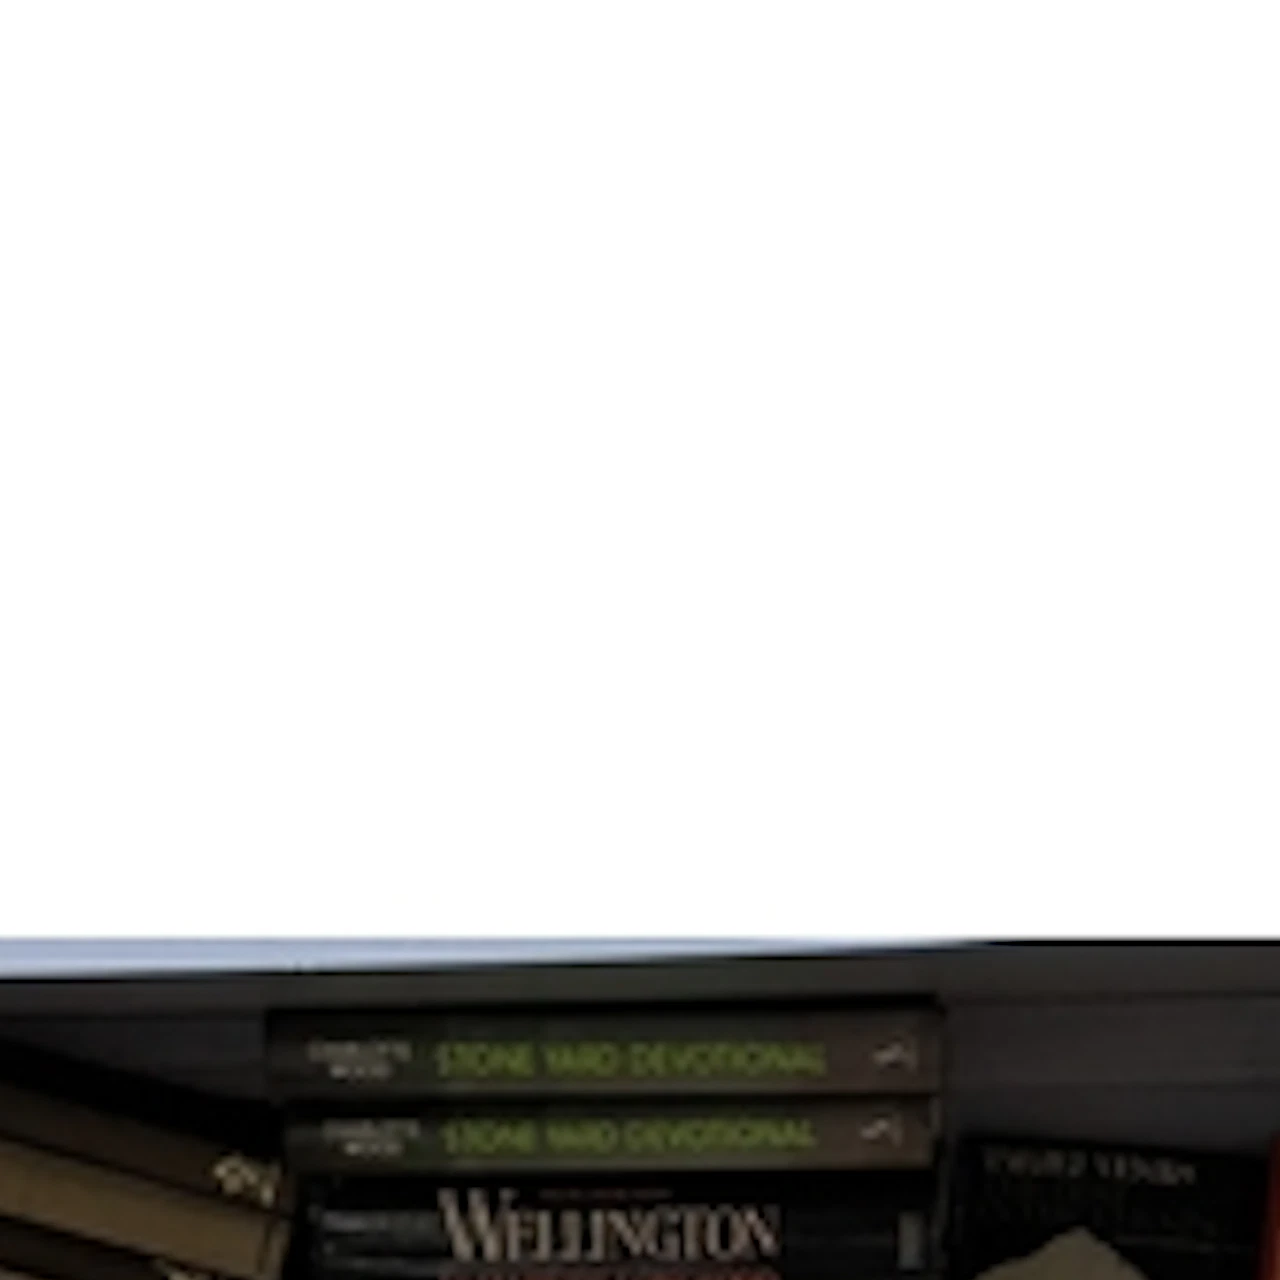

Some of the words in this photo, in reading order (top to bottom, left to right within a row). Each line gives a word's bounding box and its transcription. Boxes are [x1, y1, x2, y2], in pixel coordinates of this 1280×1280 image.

[436, 1040, 534, 1079] STONE
[545, 1041, 621, 1079] YARD
[629, 1040, 827, 1078] DEVOTIONAL
[439, 1118, 536, 1155] STONE
[545, 1117, 618, 1153] YARD
[625, 1116, 818, 1151] DEVOTIONAL
[436, 1187, 782, 1264] WELLINGTON
